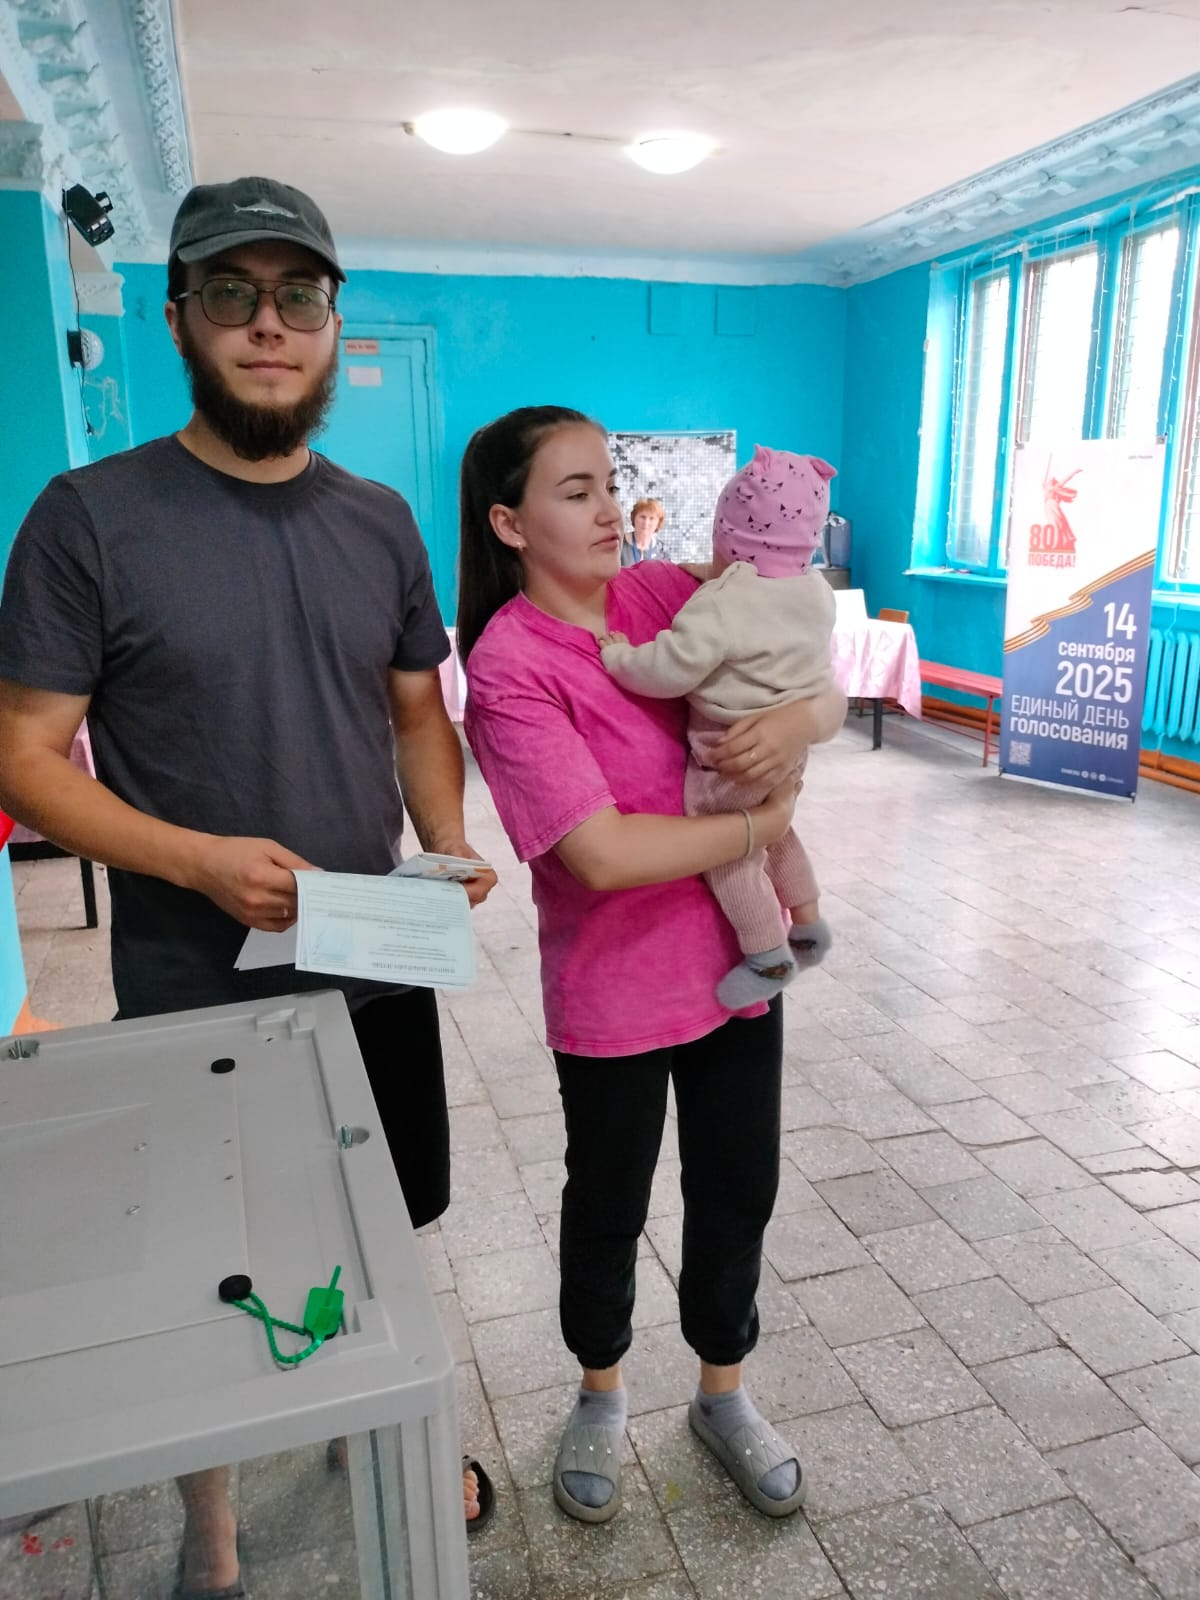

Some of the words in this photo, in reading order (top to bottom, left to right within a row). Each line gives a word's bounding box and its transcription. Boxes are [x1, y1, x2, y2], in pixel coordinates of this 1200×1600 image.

[1029, 523, 1056, 549] 80
[1028, 553, 1076, 569] ПОБЕДА!
[1104, 602, 1137, 640] 14
[1058, 641, 1136, 665] сентября
[1055, 660, 1133, 703] 2025
[1011, 694, 1079, 721] ЕДИНЫЙ
[1082, 704, 1130, 729] ДЕНЬ
[1010, 717, 1129, 750] голосования
